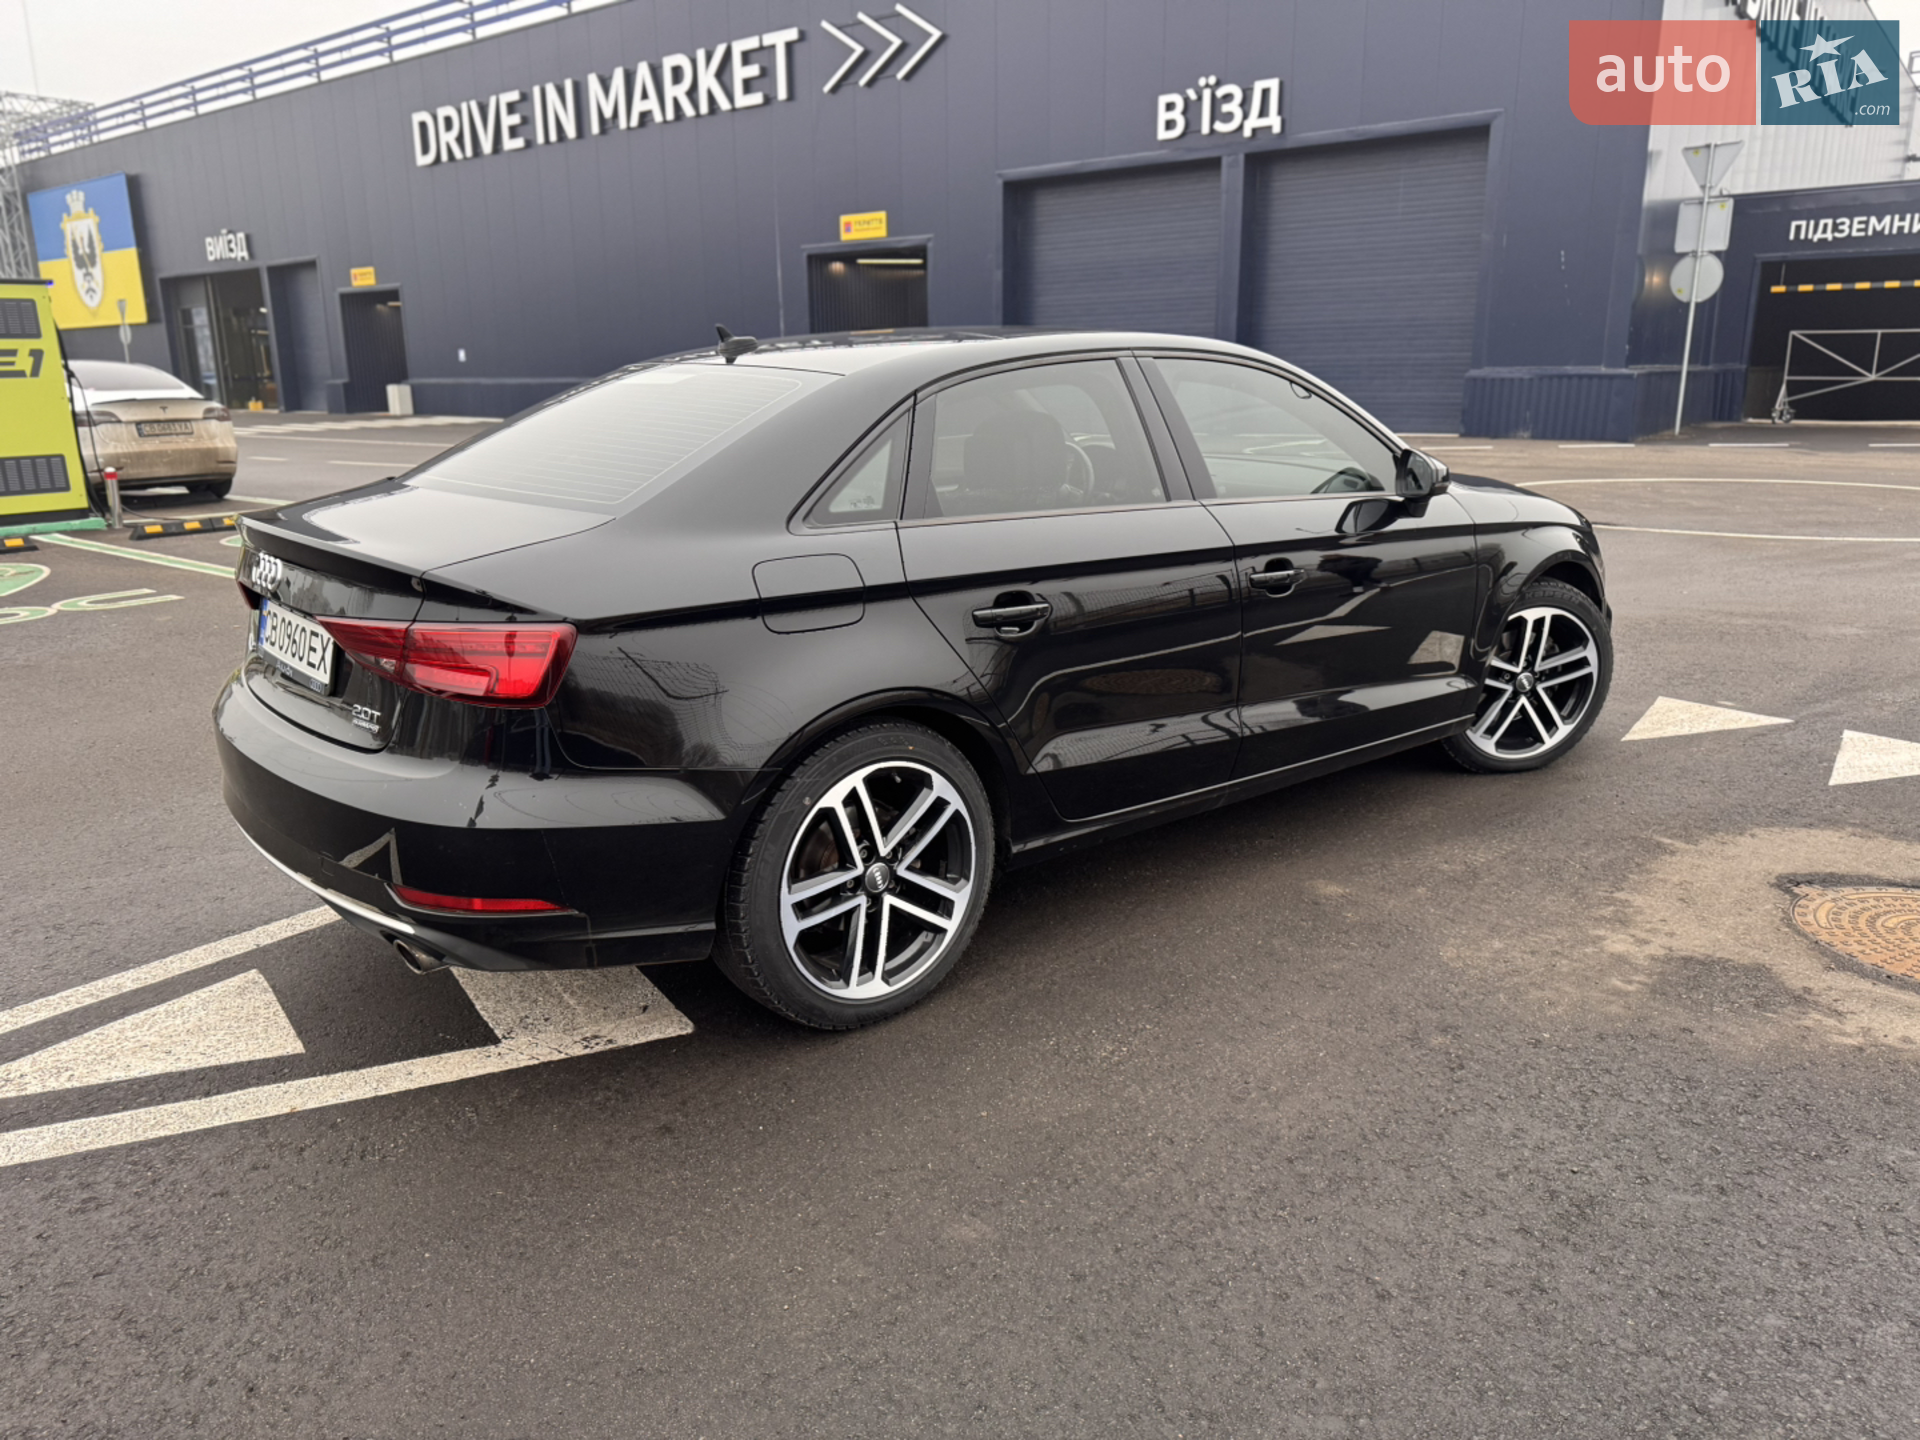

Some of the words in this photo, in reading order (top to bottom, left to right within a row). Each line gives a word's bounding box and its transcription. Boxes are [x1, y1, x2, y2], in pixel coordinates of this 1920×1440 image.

[411, 89, 526, 167] DRIVE
[532, 77, 577, 145] IN
[587, 26, 799, 135] MARKET
[204, 228, 250, 262] ВИЇЗД
